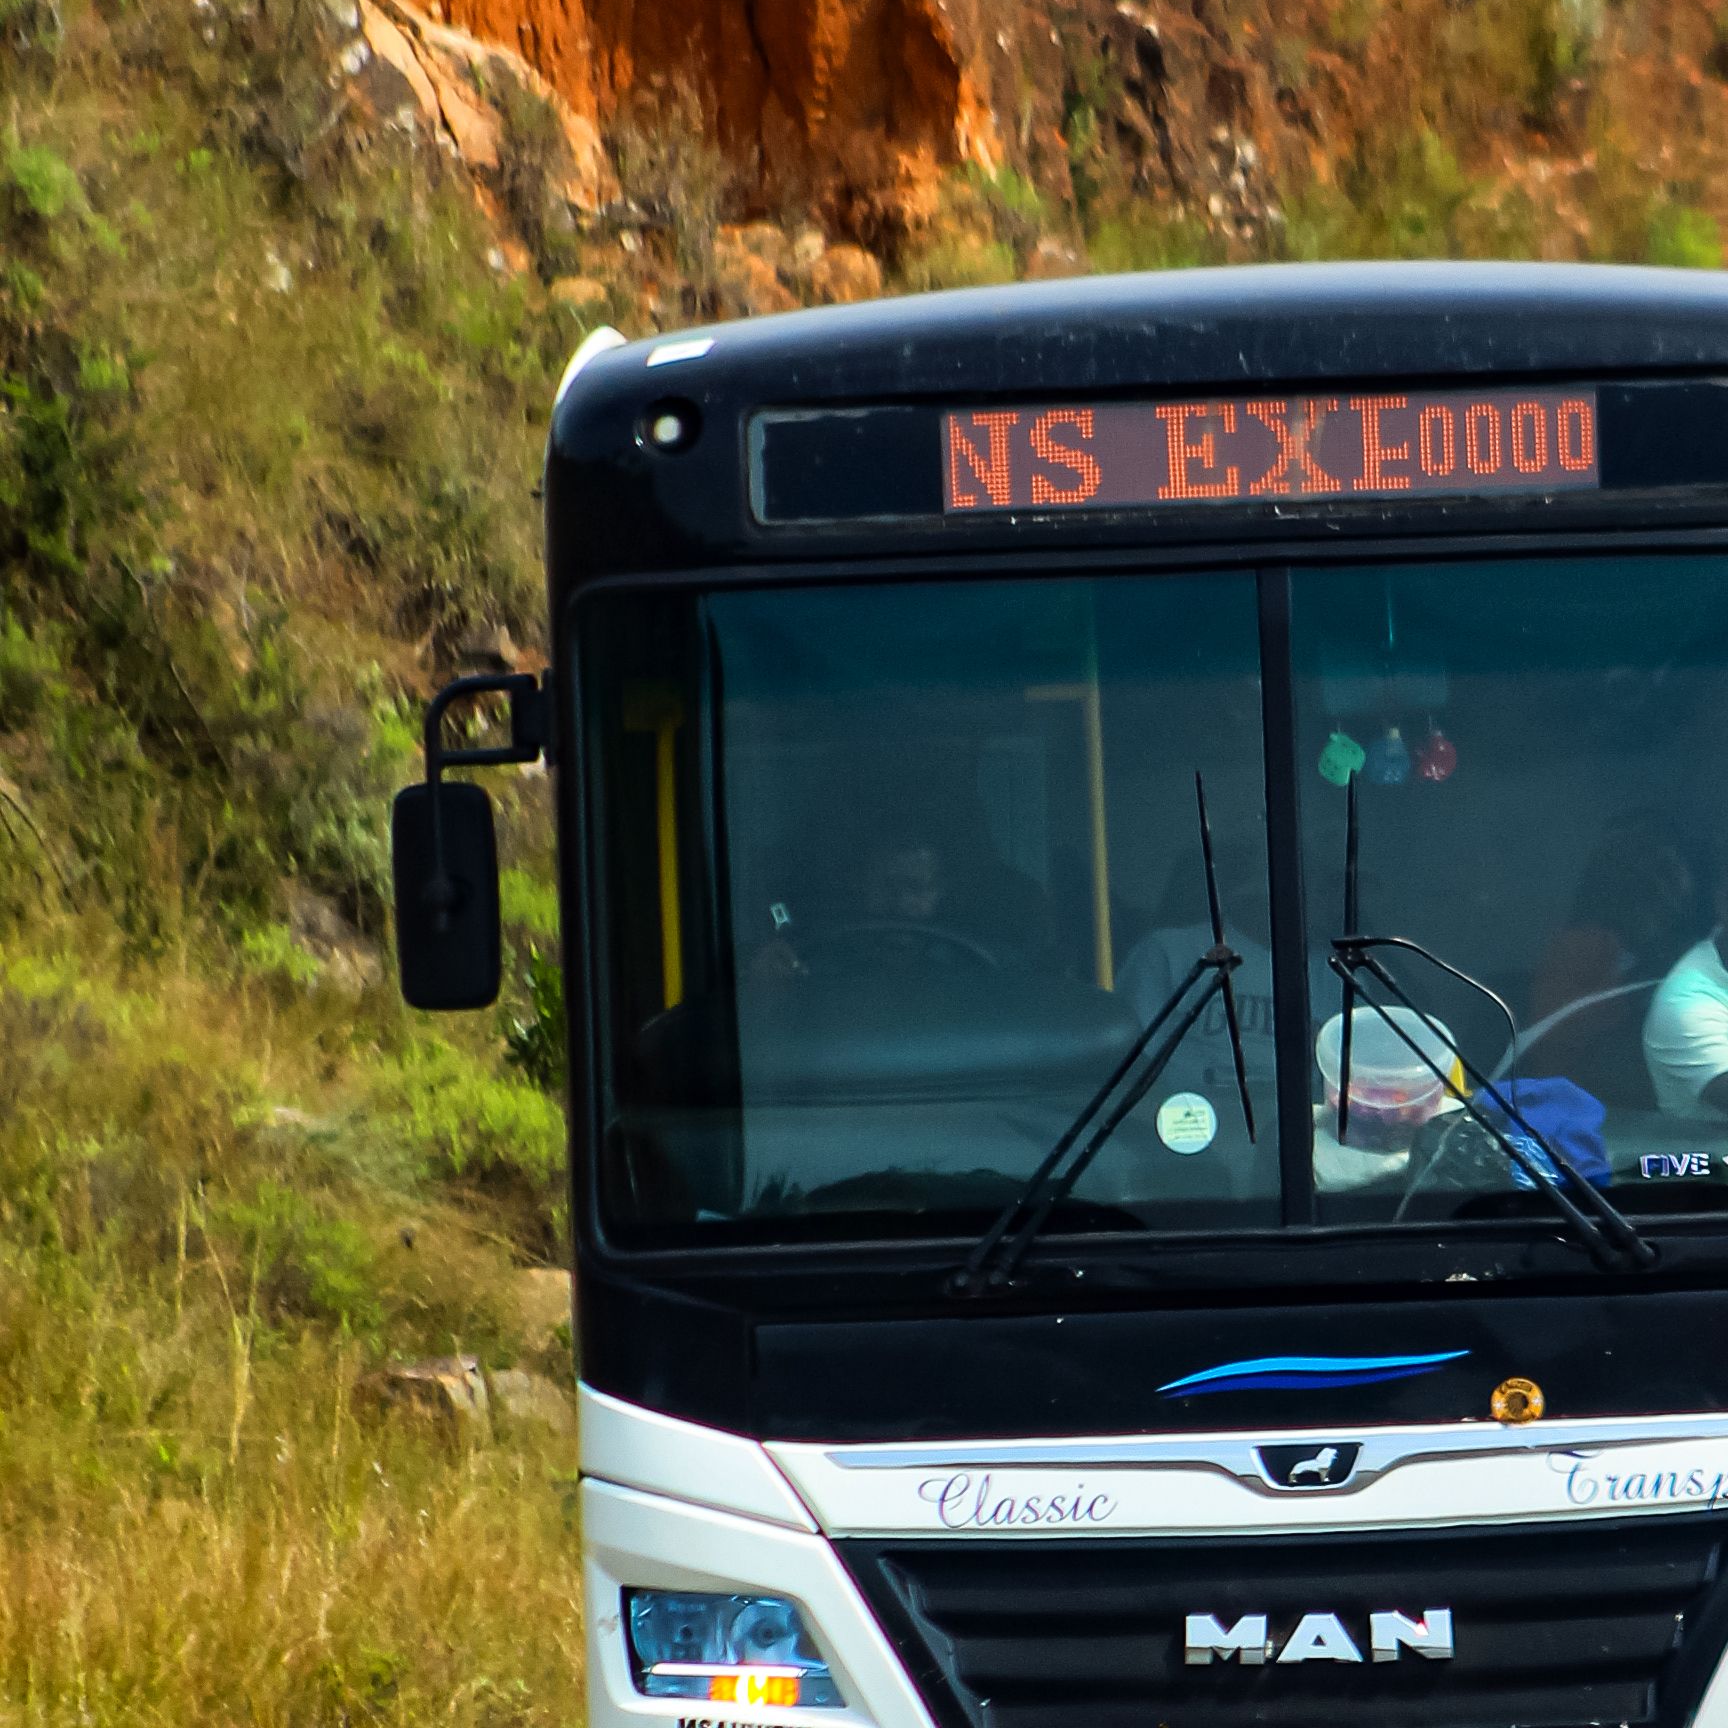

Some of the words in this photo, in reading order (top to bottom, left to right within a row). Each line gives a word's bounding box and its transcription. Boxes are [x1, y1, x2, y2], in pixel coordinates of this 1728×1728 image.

[949, 408, 1102, 508] NS
[918, 1472, 1118, 1529] Classic
[1184, 1606, 1454, 1665] MAN
